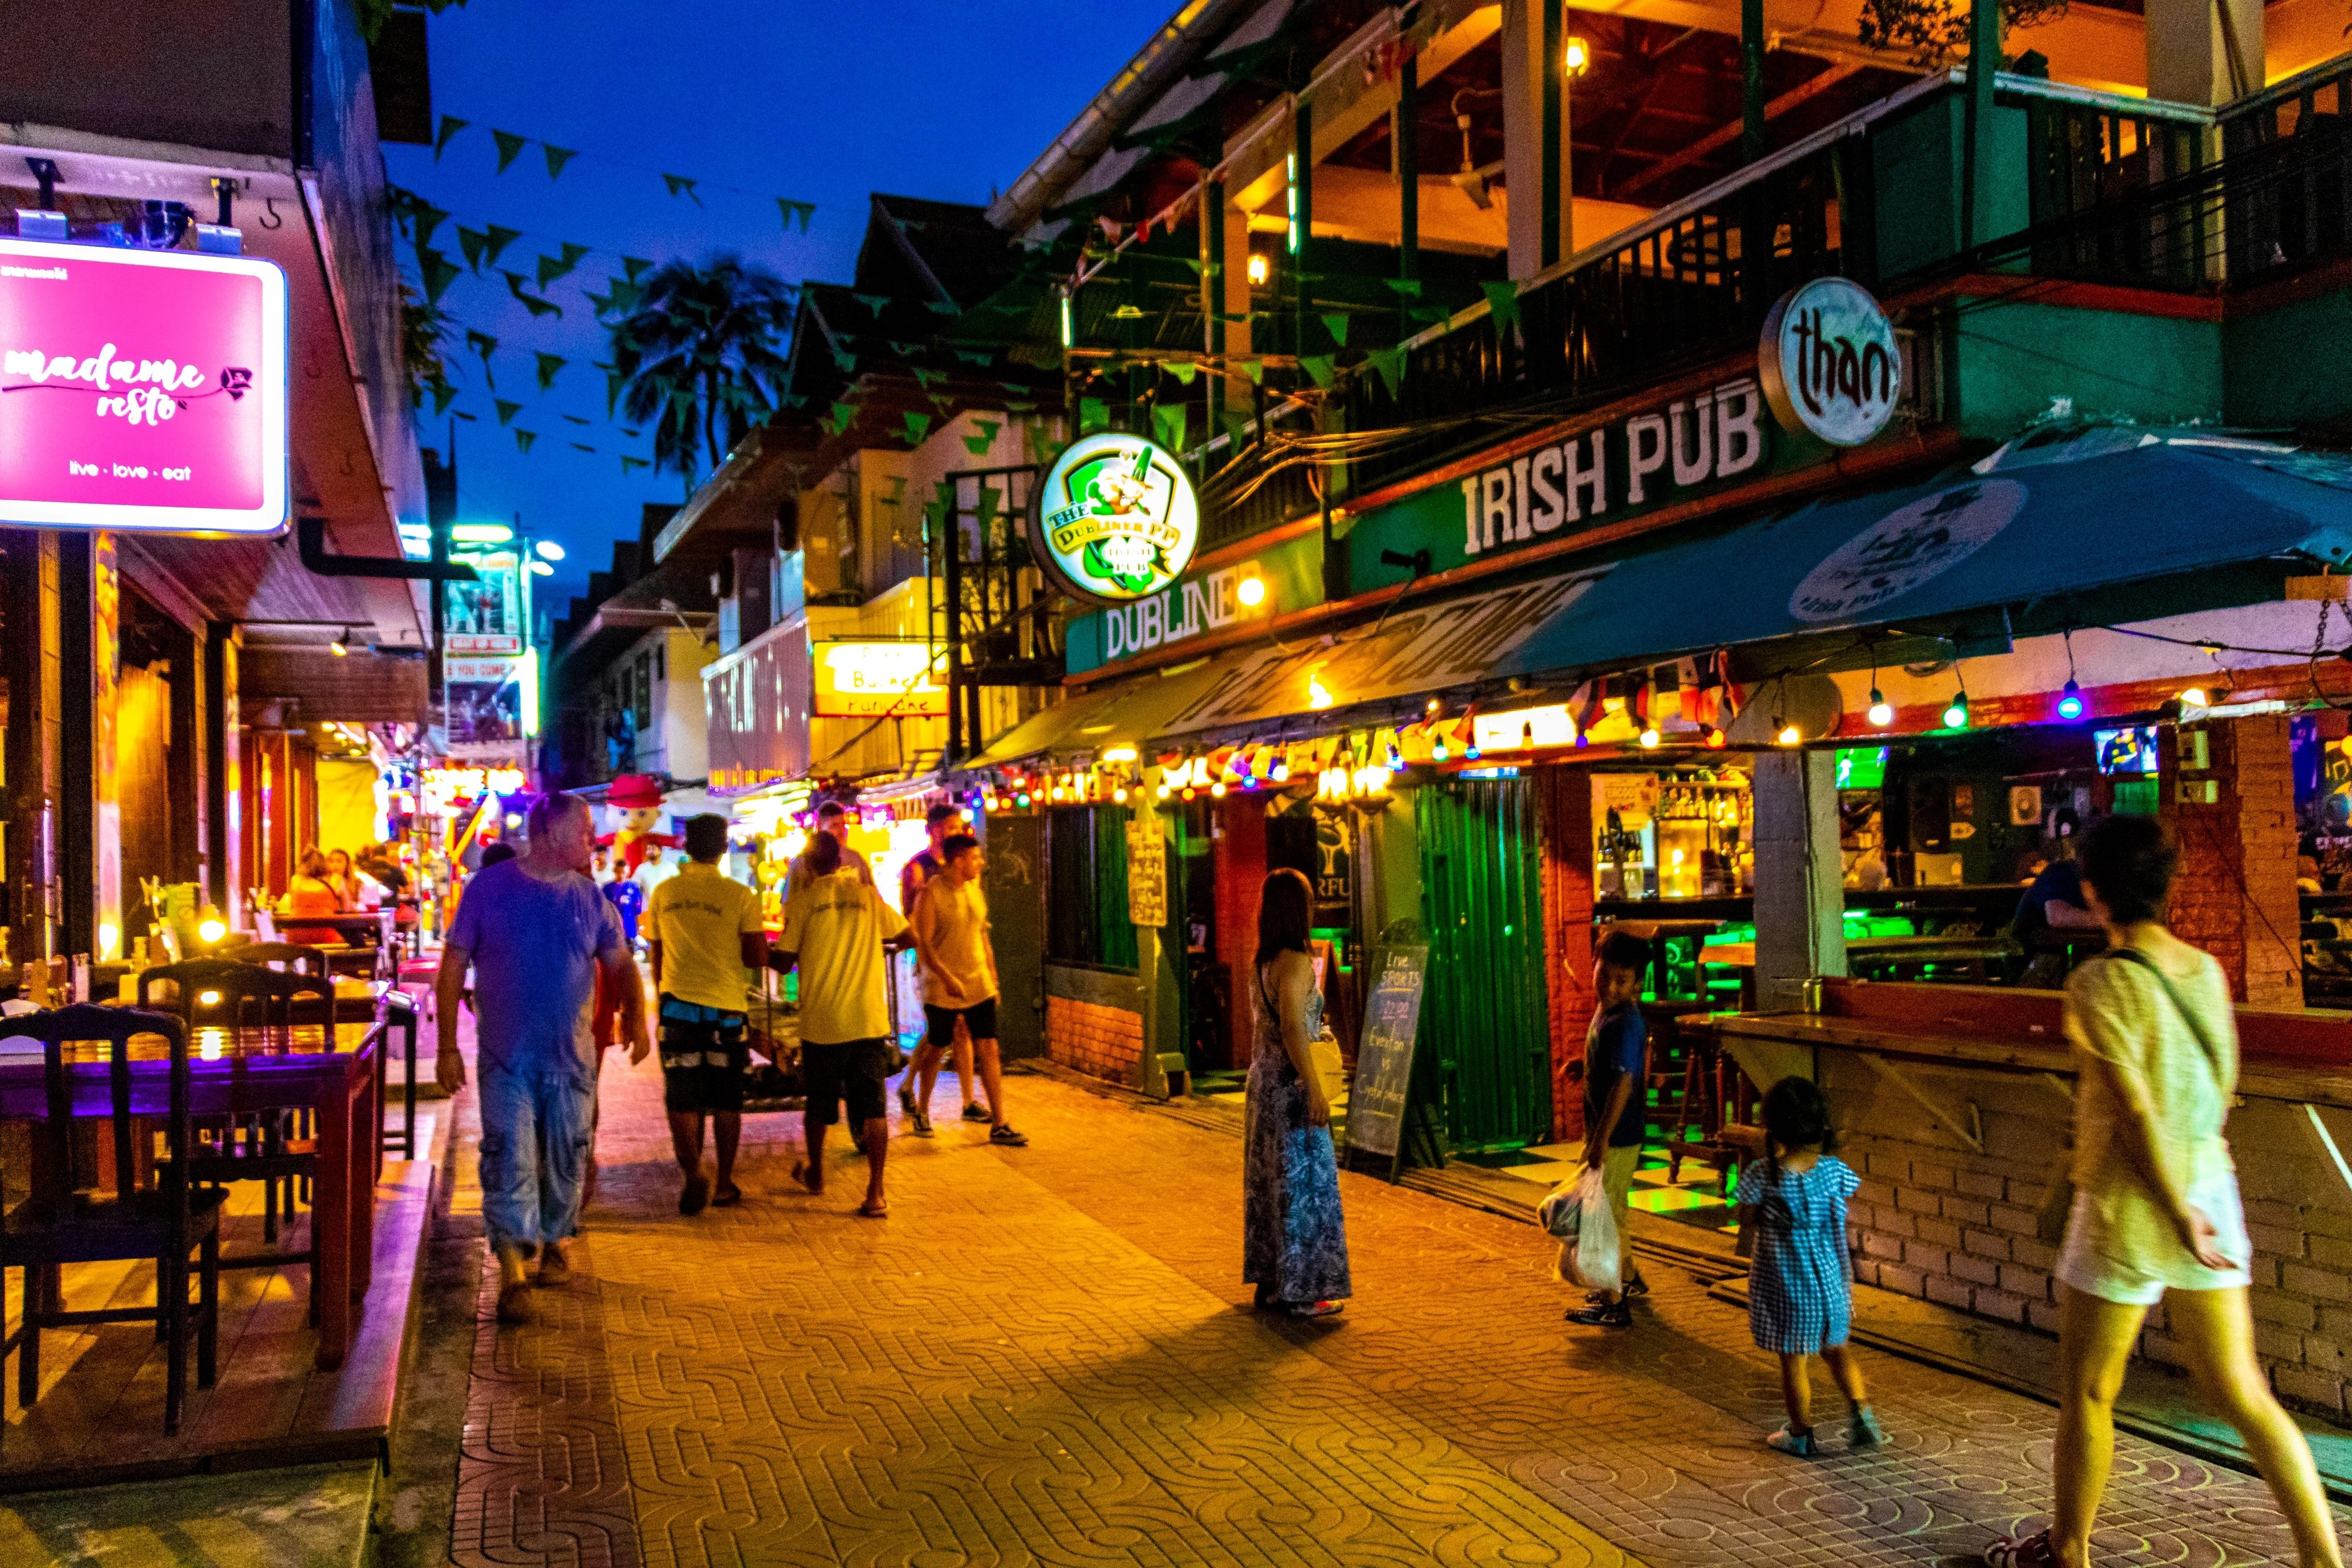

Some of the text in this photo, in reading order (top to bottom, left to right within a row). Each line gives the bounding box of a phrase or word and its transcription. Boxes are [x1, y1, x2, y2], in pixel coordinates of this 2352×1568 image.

[4, 343, 205, 391] madame
[1792, 306, 1889, 417] than
[96, 387, 176, 426] resto
[69, 460, 191, 482] live love eat
[1461, 377, 1762, 556] IRISH PUB
[1049, 503, 1089, 527] THE
